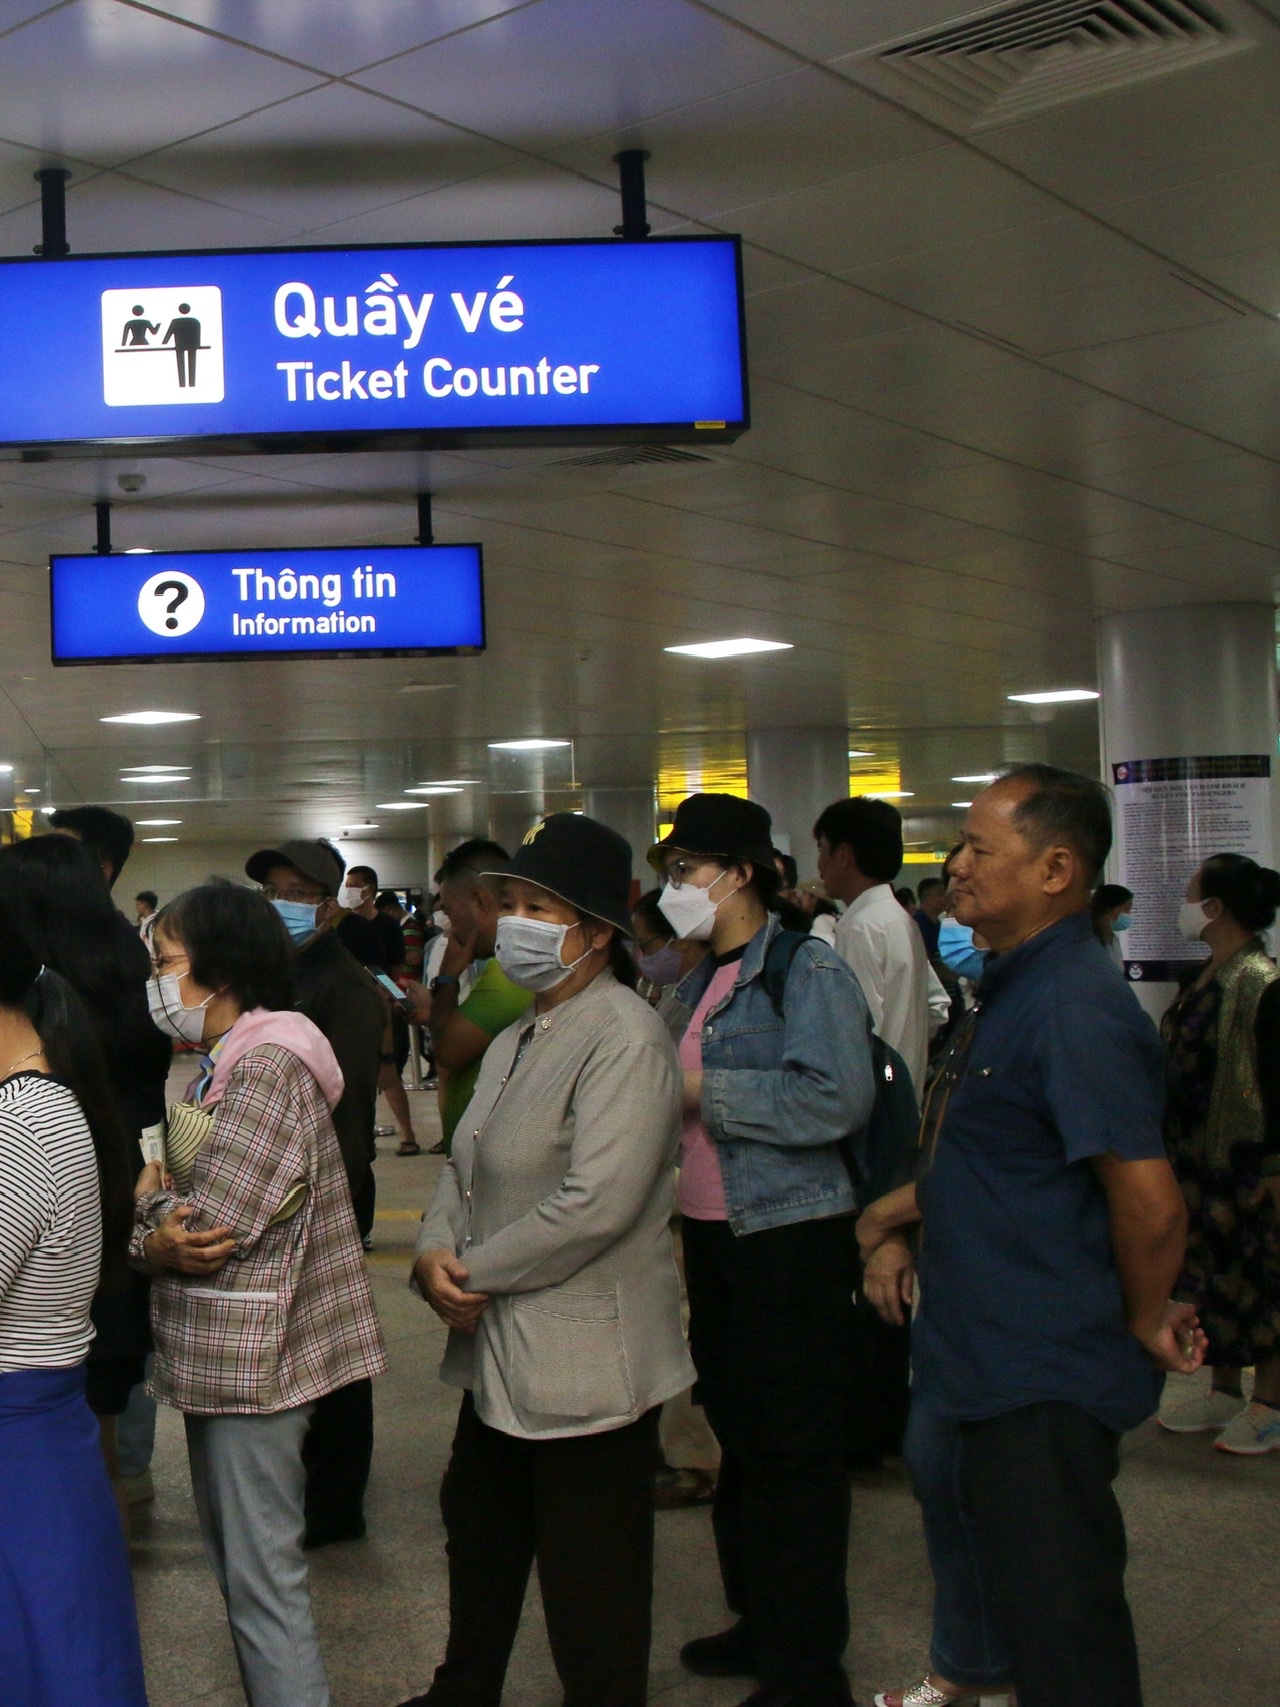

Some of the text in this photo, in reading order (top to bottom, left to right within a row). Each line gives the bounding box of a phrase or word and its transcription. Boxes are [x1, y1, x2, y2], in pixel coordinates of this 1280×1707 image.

[274, 273, 524, 350] Quầy vé
[276, 356, 600, 401] Ticket Counter
[232, 568, 342, 607] Thông
[353, 565, 396, 598] tin
[233, 611, 376, 636] Information
